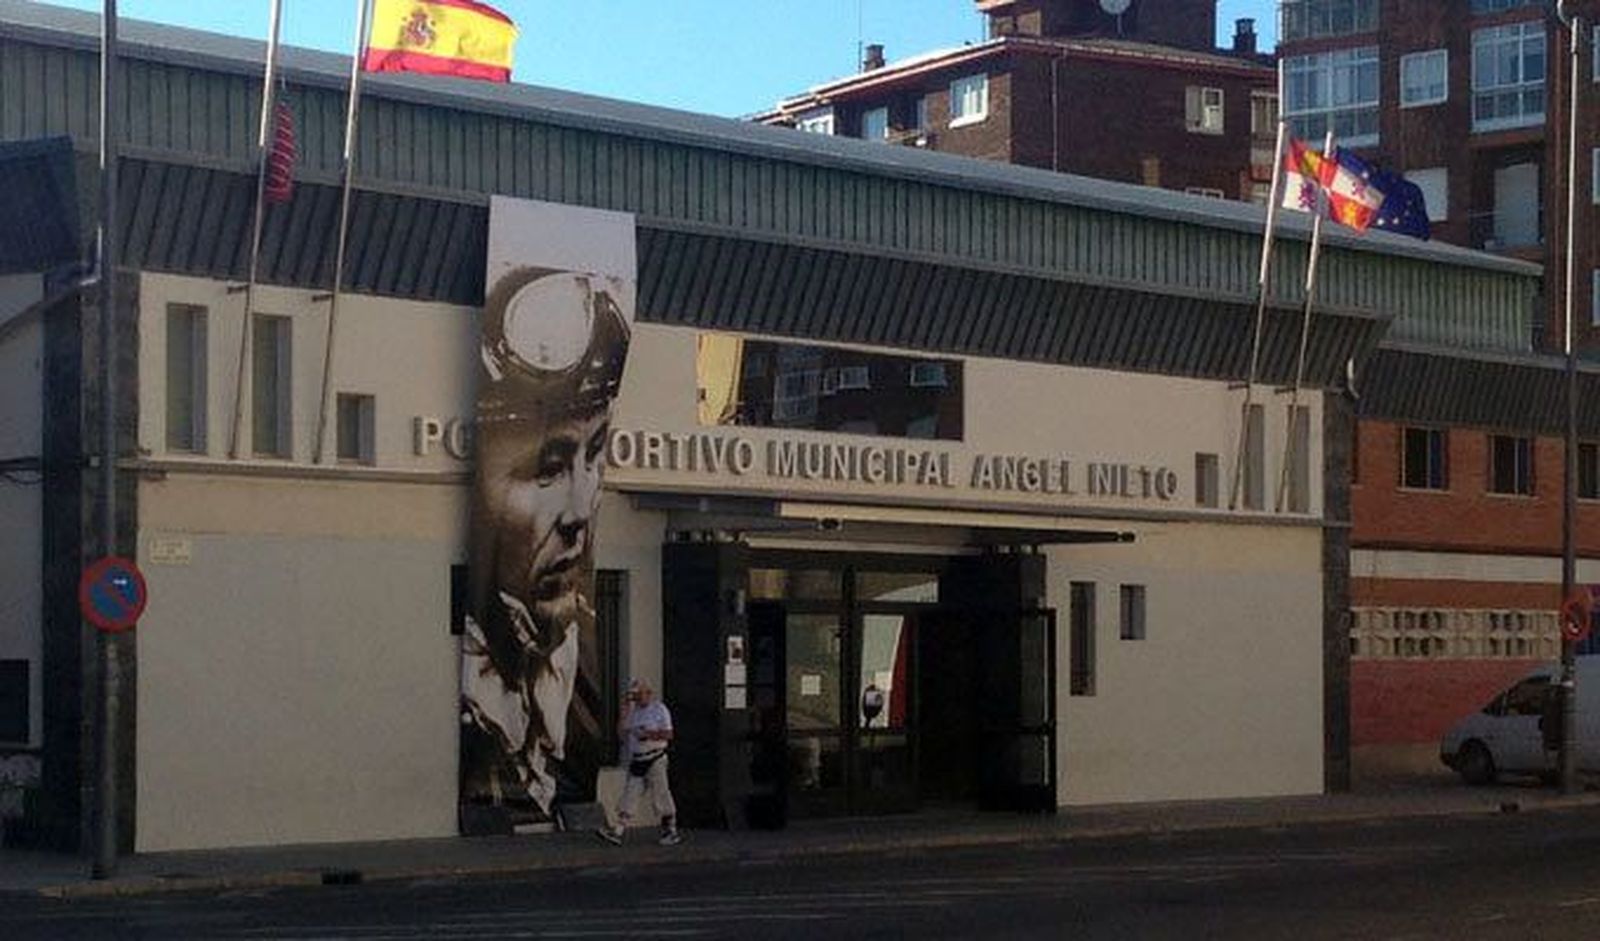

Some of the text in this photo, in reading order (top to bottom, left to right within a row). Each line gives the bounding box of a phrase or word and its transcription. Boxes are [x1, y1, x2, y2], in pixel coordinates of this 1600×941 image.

[767, 440, 956, 488] MUNICIPAL
[970, 454, 1077, 495] ANGEL
[1088, 463, 1178, 500] NIETO
